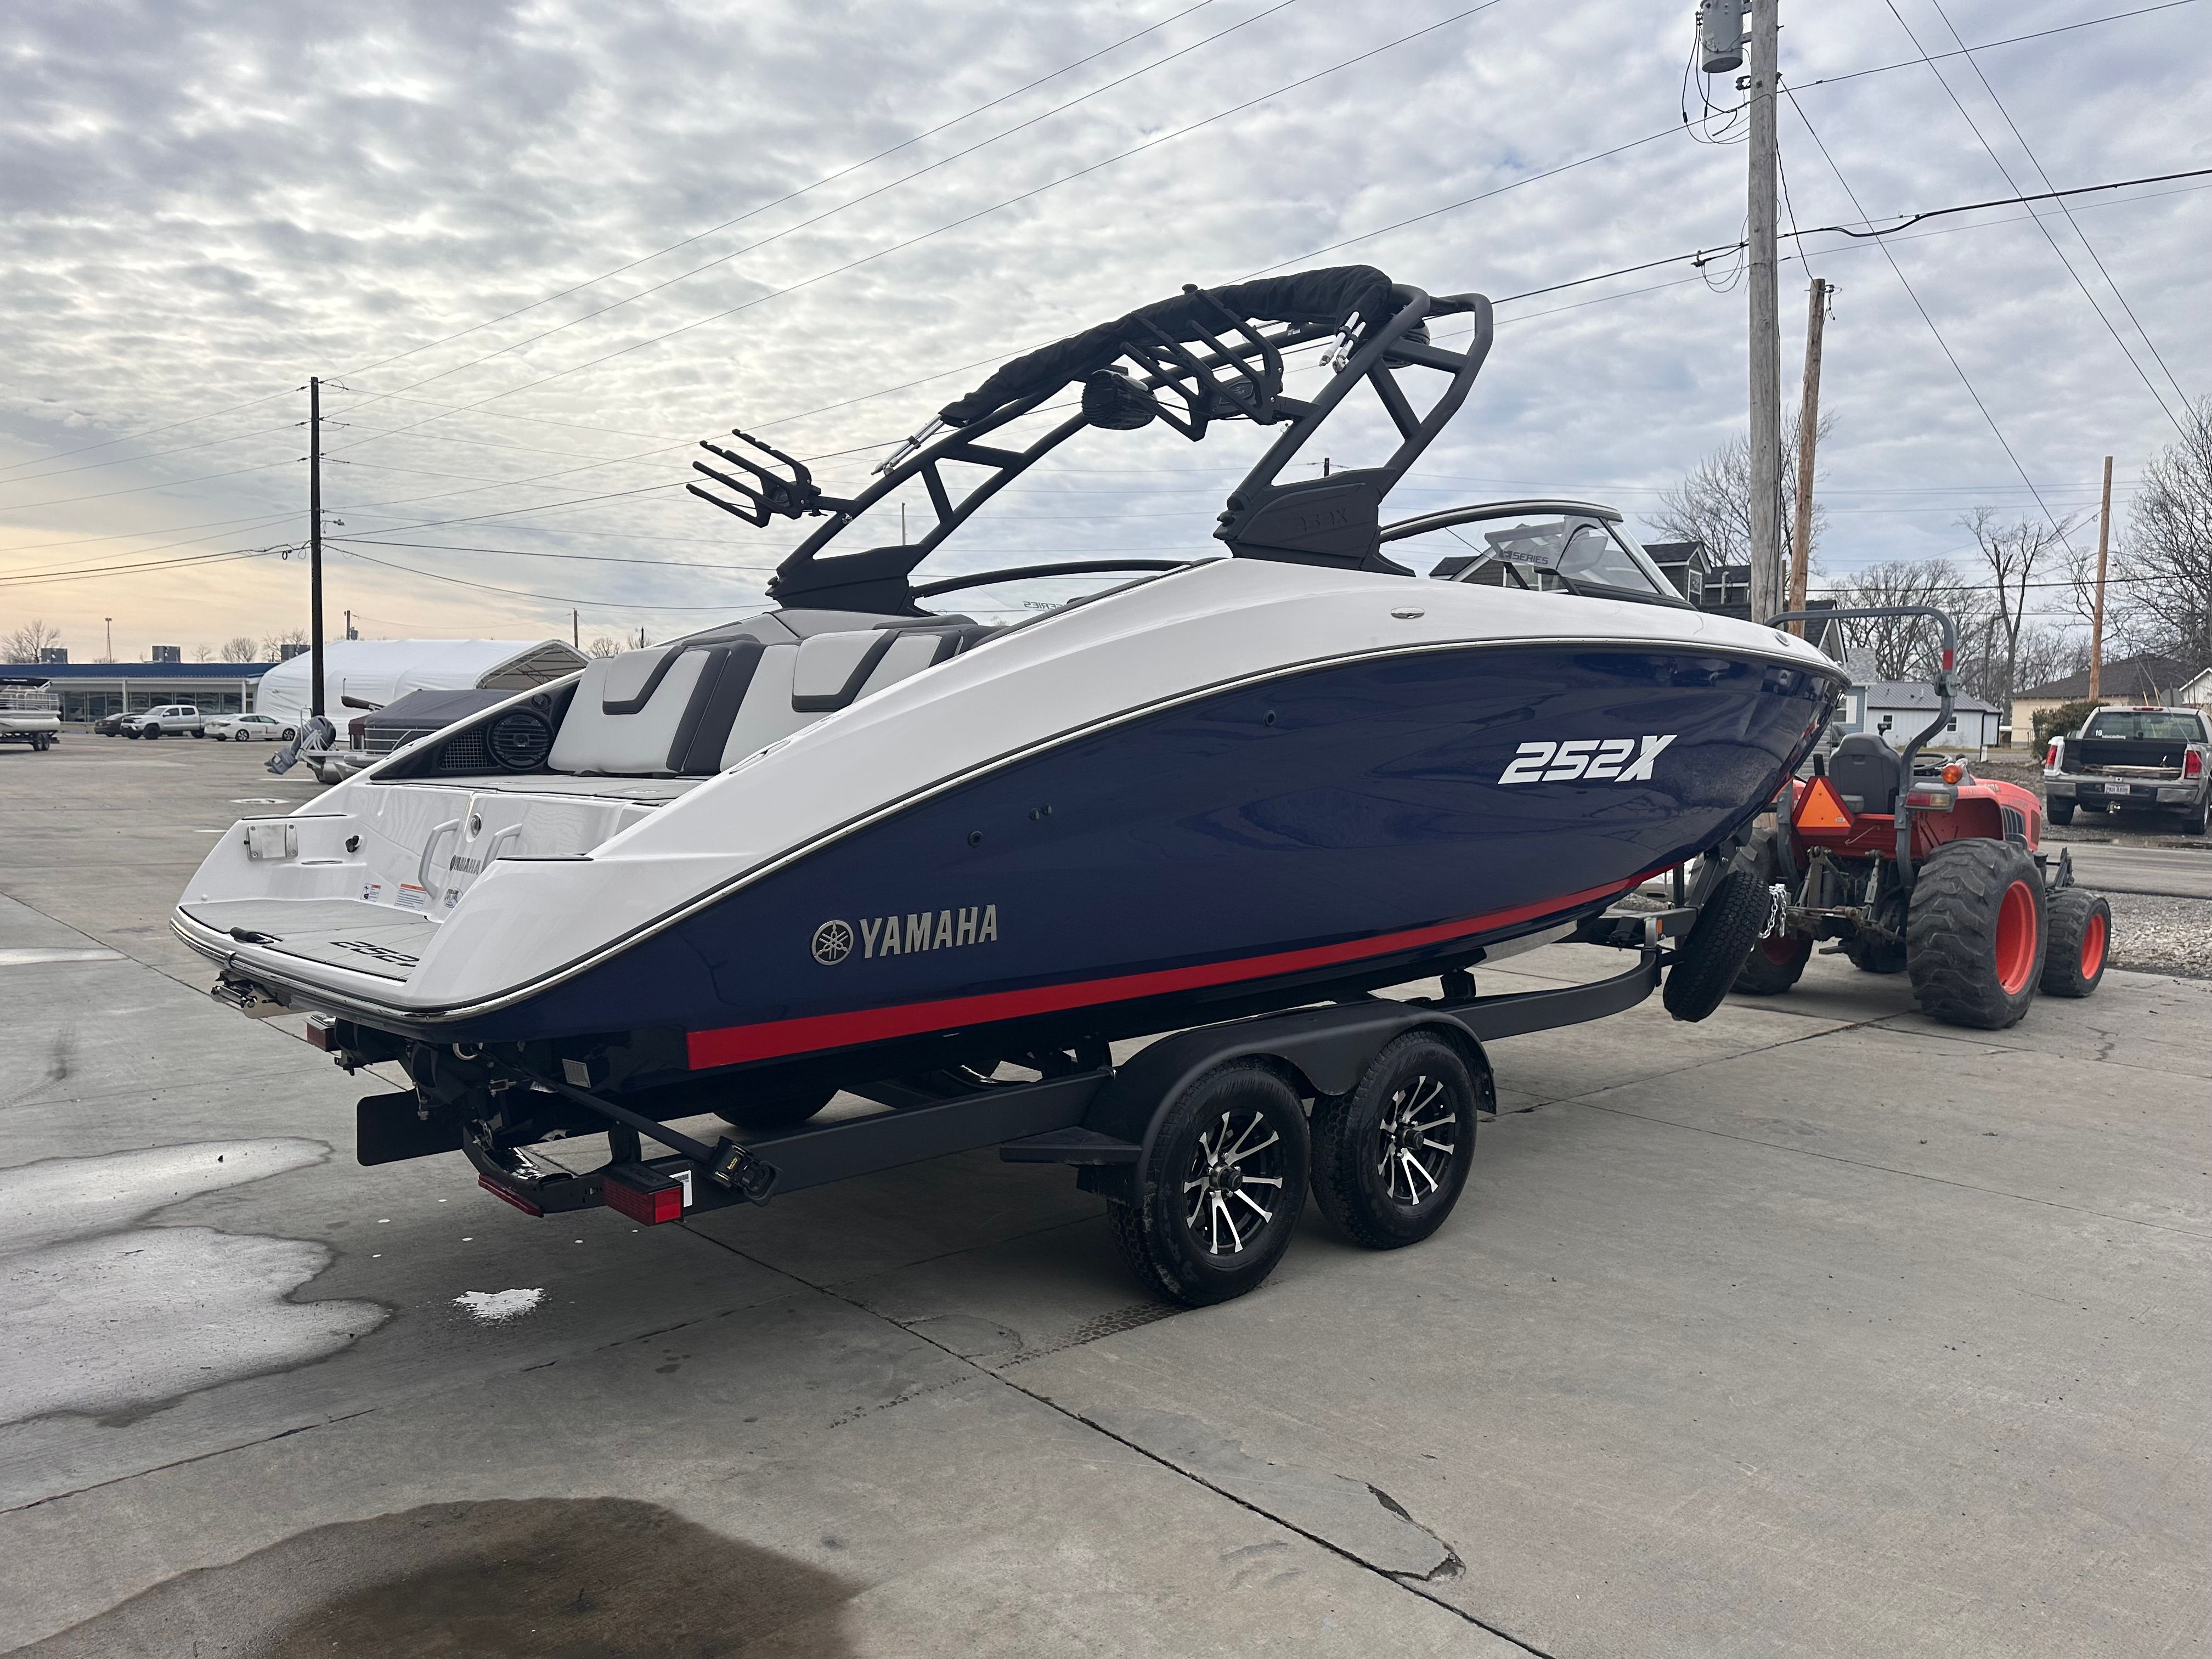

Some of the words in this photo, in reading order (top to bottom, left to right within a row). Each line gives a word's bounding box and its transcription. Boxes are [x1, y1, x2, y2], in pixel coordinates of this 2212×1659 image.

[1512, 552, 1548, 565] SERIES
[1498, 735, 1678, 785] 252X
[454, 856, 481, 874] YAMAHA
[859, 904, 997, 958] YAMAHA
